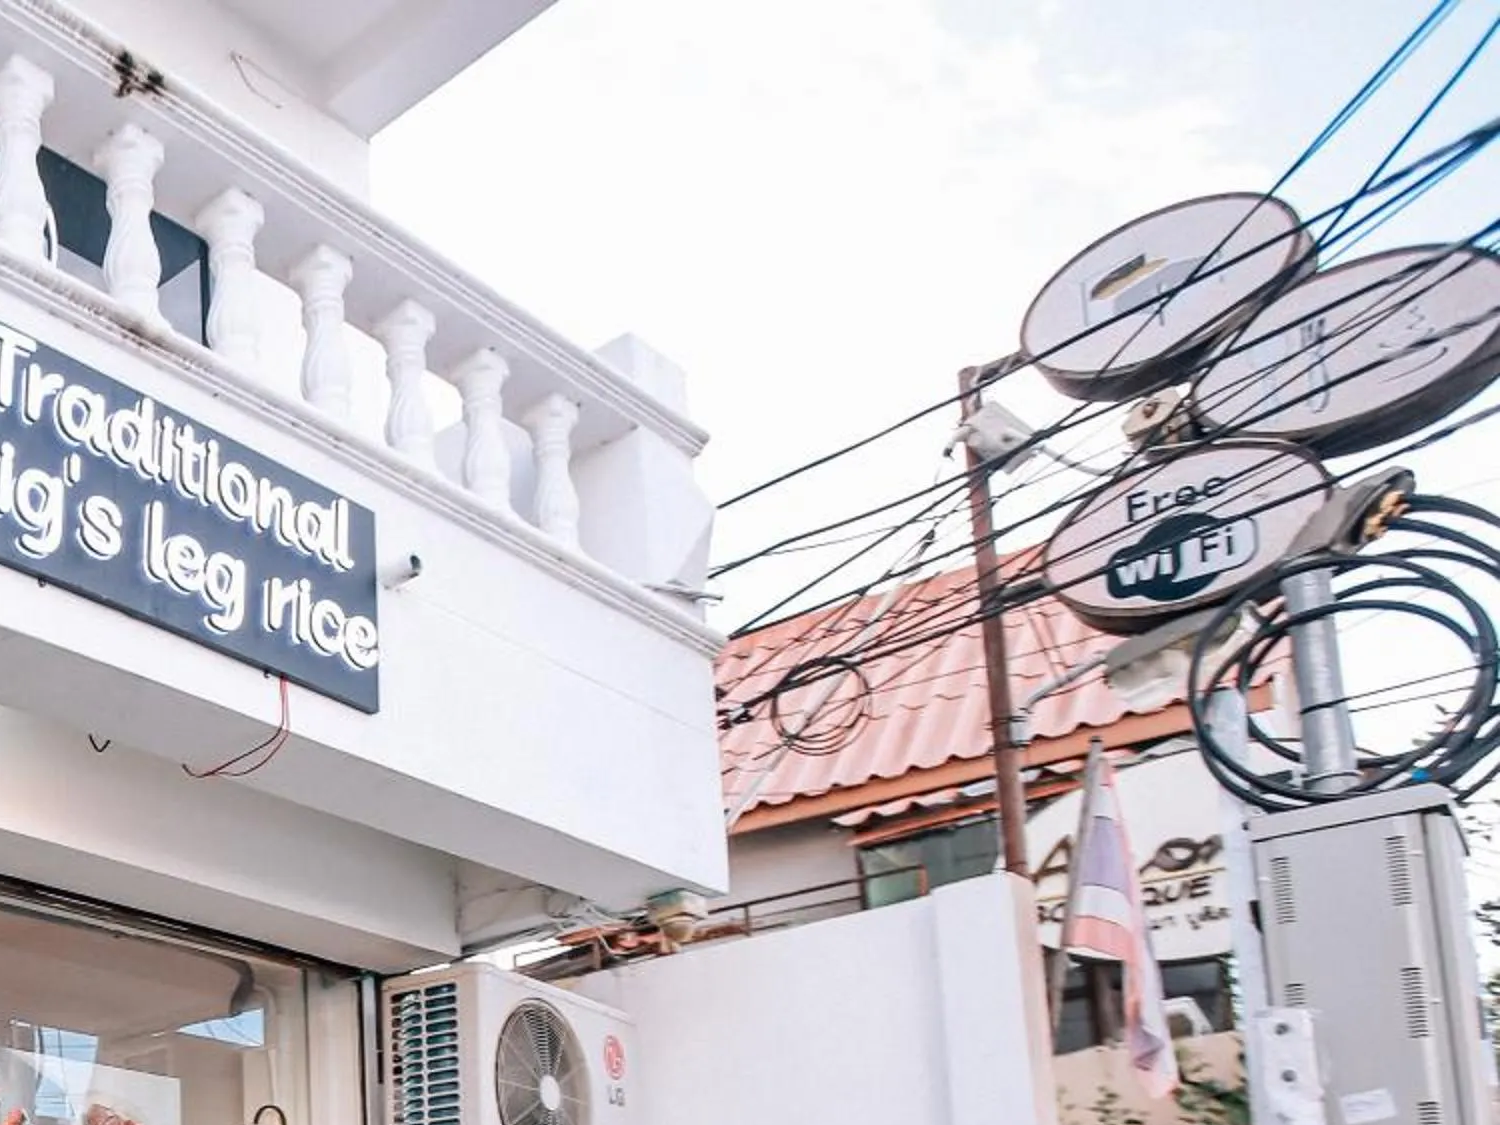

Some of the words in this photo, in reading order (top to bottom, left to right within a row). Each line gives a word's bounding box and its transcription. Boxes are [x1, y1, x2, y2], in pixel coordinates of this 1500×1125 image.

[1126, 477, 1223, 523] Free
[143, 500, 246, 633] leg
[264, 576, 380, 670] rice
